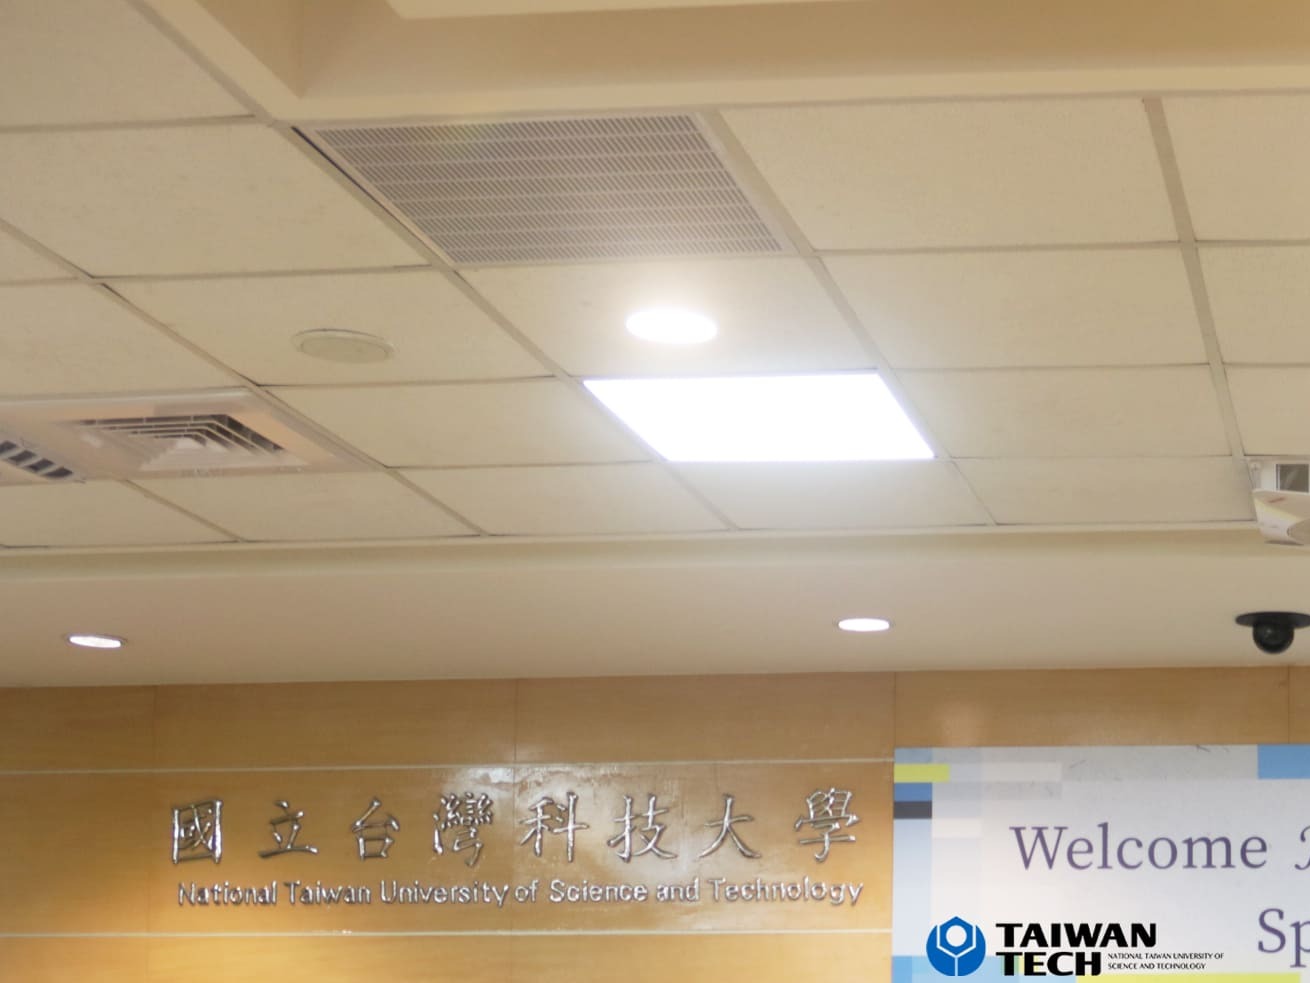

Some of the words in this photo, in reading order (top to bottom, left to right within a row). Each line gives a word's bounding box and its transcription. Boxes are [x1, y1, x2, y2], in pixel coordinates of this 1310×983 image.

[172, 787, 861, 867] 國立台灣科技大學
[1009, 822, 1267, 870] Welcome
[178, 880, 277, 904] National
[284, 880, 371, 905] Taiwan
[380, 879, 509, 907] University
[515, 879, 540, 903] of
[549, 878, 649, 903] Science
[656, 876, 700, 902] and
[707, 875, 864, 907] Technology
